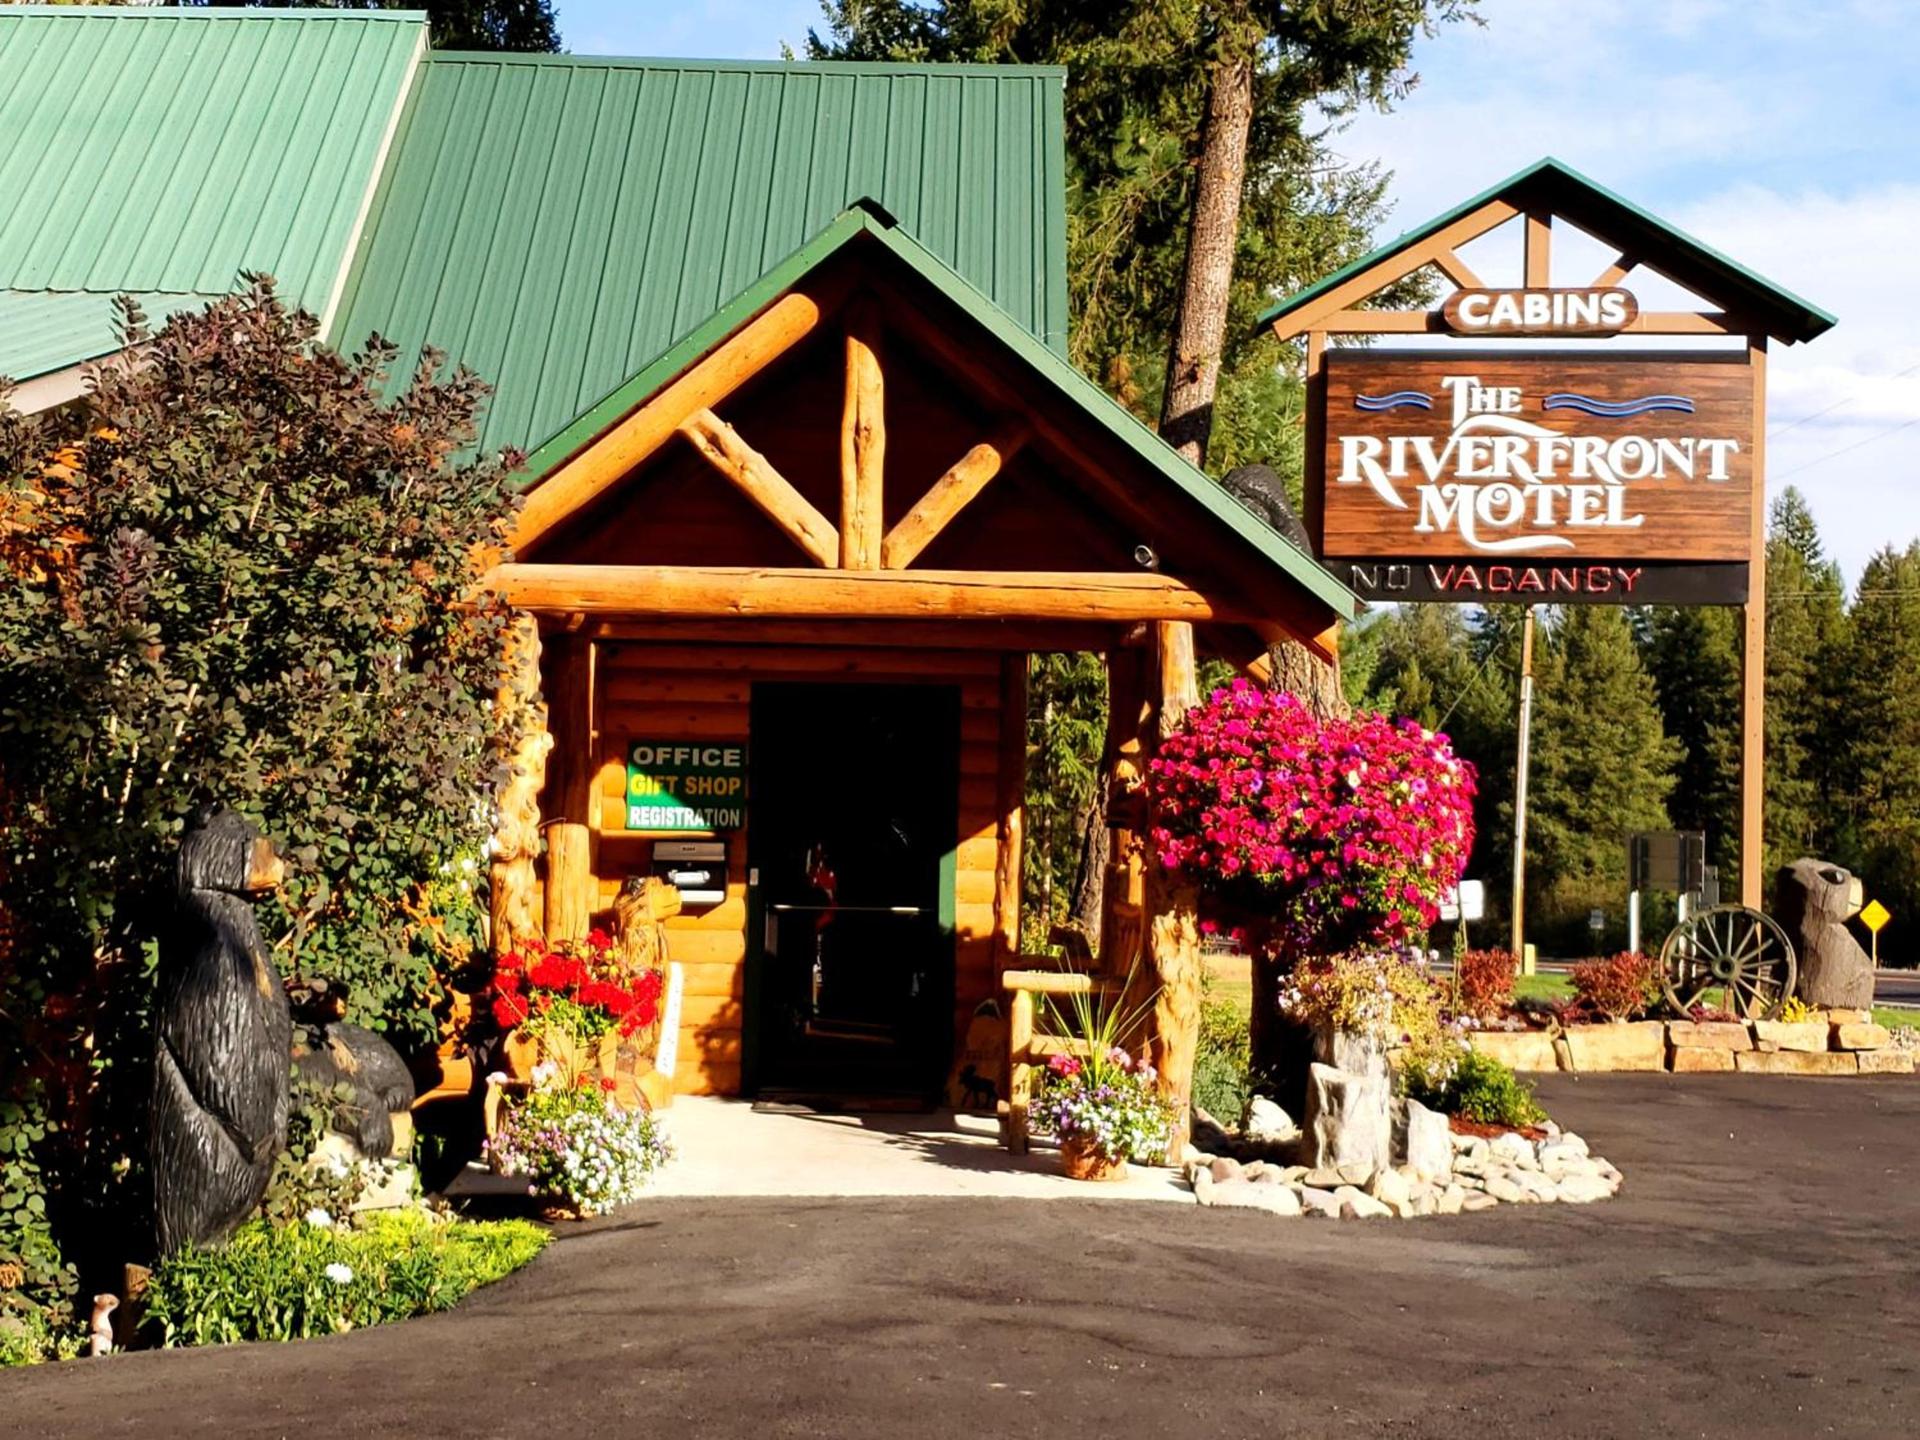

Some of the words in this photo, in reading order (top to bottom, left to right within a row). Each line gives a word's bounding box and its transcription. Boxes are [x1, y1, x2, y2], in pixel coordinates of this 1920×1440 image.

[1457, 292, 1626, 326] CABINS
[1336, 430, 1740, 509] RIVERFRONT
[1412, 483, 1646, 551] MOTEL
[1351, 564, 1411, 590] NO
[1429, 564, 1641, 593] VACANCY
[632, 747, 741, 767] OFFICE
[630, 774, 679, 795] GIFT
[685, 776, 741, 795] SHOP
[629, 806, 740, 827] REGISTRATION
